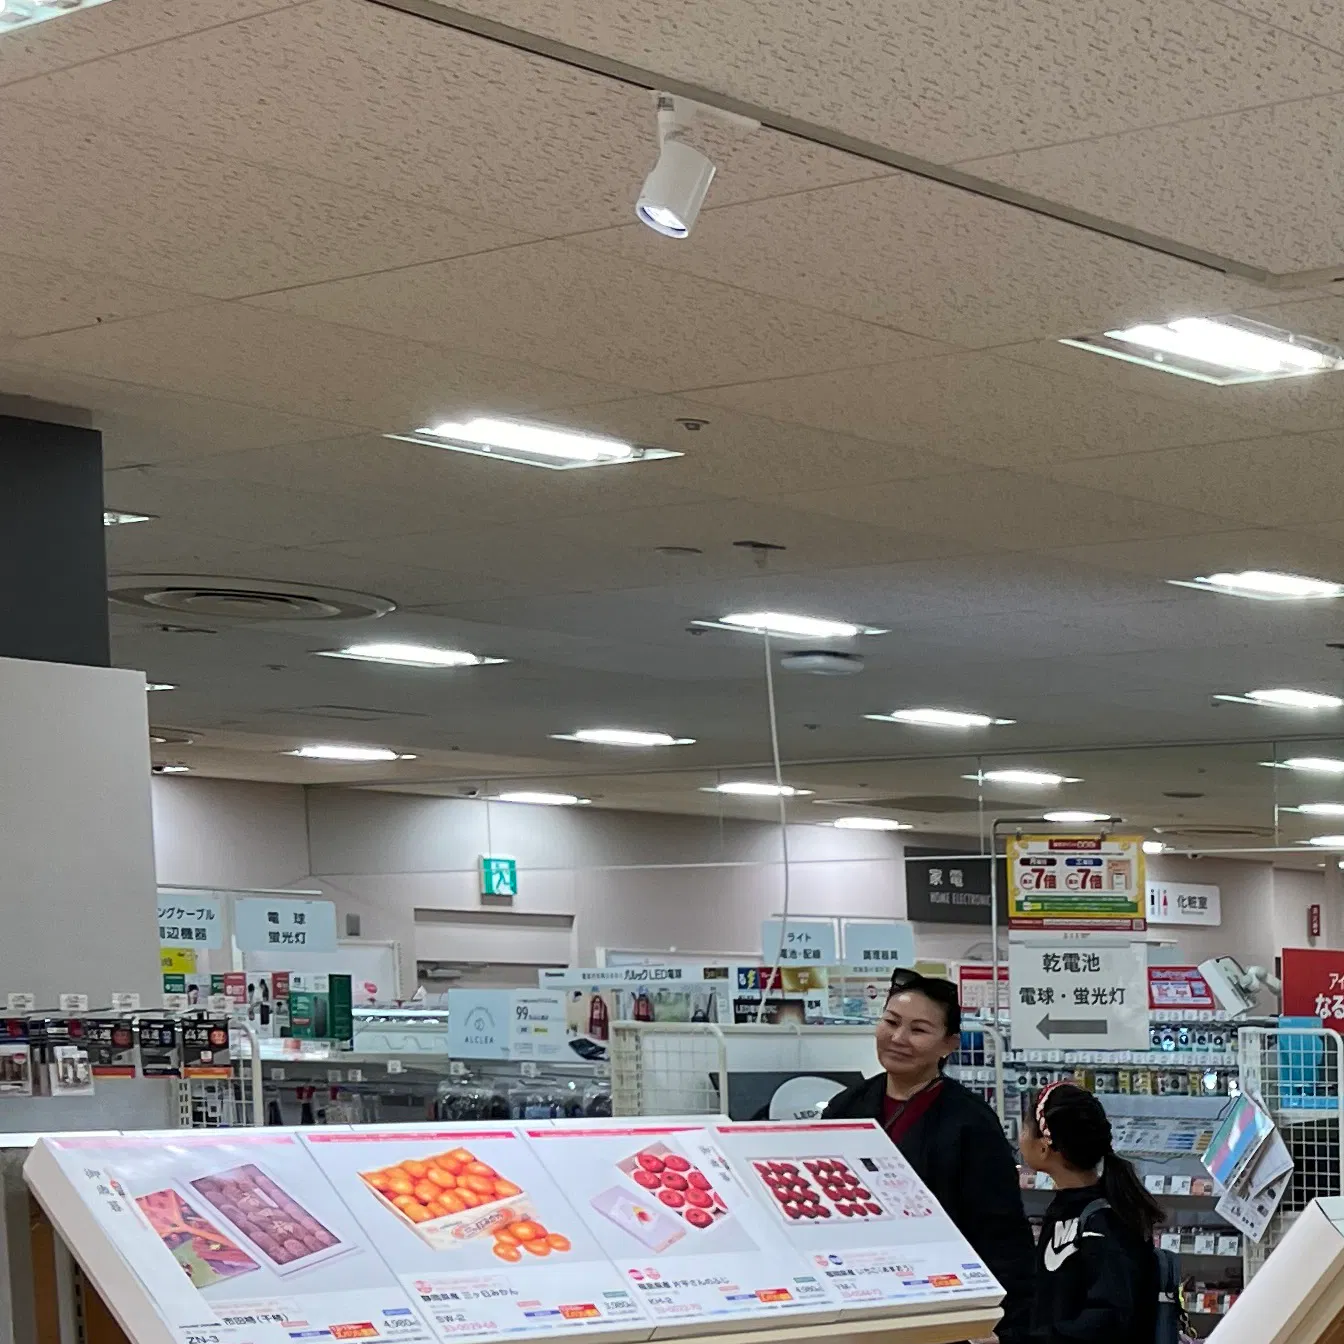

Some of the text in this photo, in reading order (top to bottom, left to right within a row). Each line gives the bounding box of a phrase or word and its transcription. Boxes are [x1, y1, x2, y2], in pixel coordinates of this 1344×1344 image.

[1043, 952, 1101, 974] 乾電池
[1019, 985, 1127, 1006] 電球・蛍光灯
